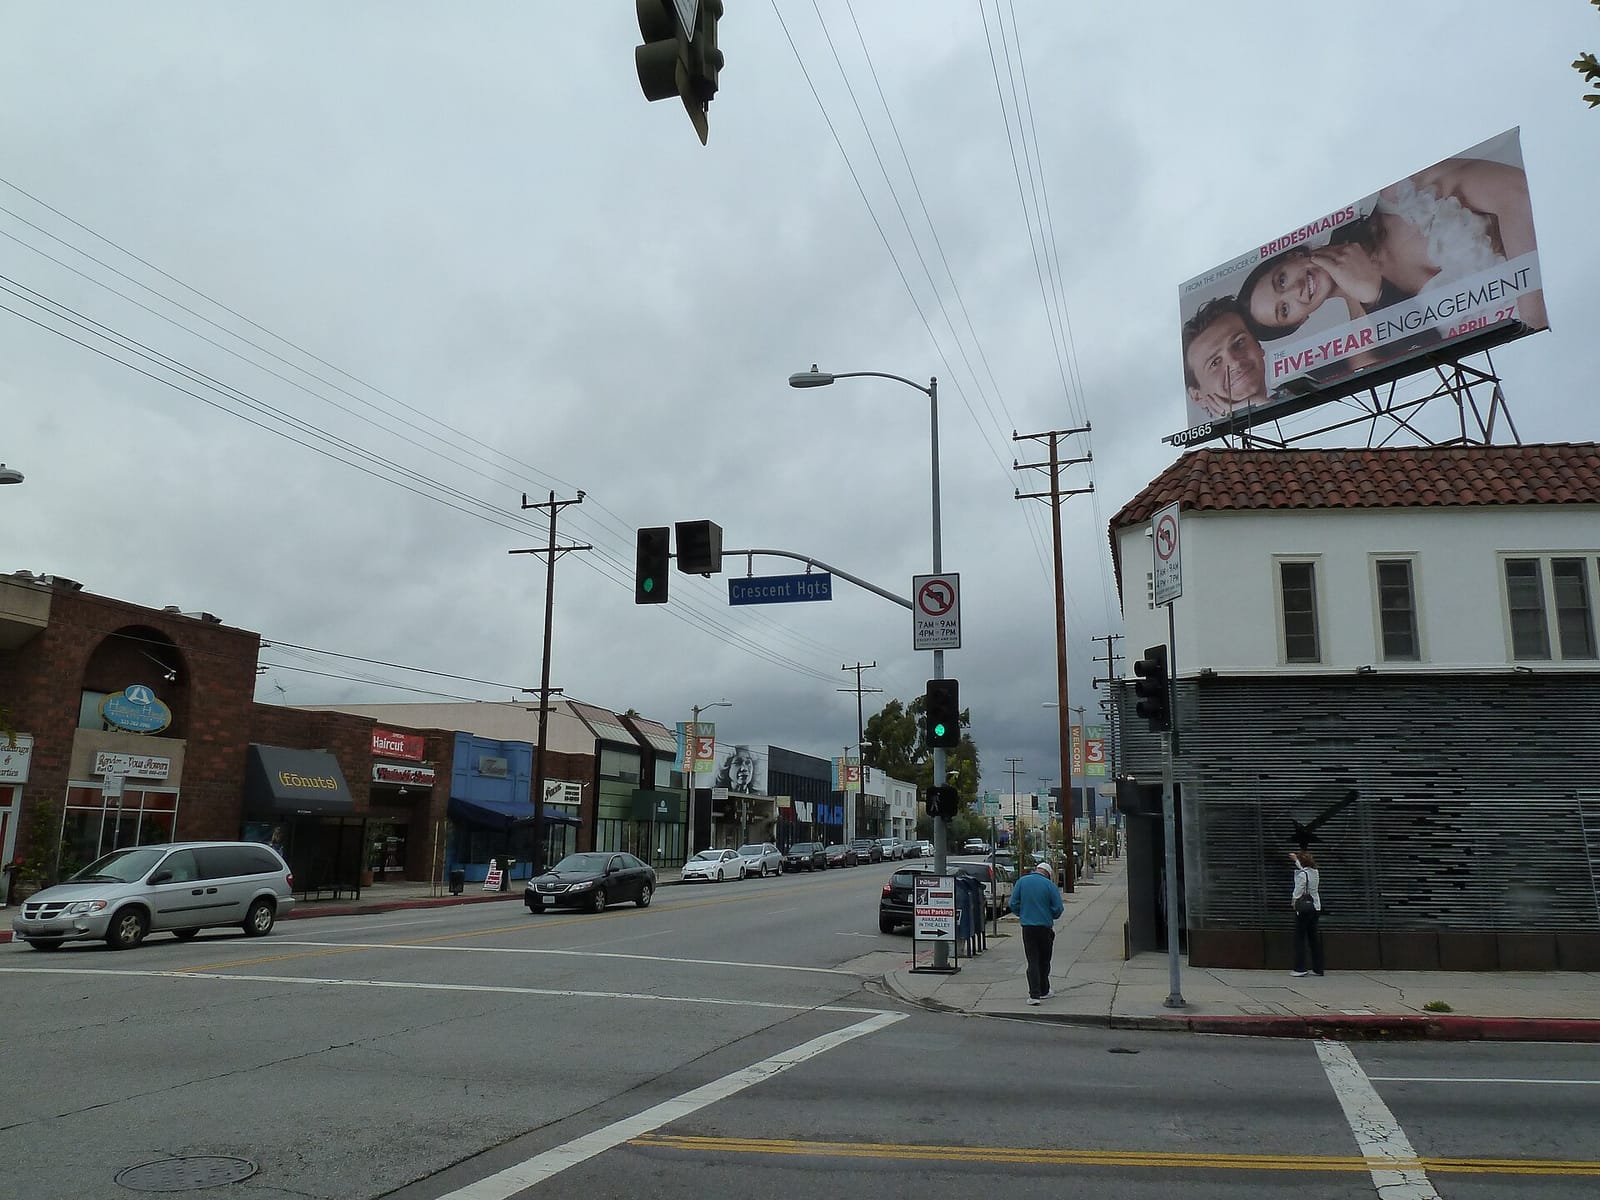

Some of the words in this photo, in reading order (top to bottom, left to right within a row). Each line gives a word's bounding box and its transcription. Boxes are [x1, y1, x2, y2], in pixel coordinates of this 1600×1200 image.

[1185, 280, 1203, 294] FROM
[1203, 273, 1216, 286] THE
[1216, 259, 1249, 279] PRODUCER
[1260, 206, 1355, 259] BRIDESMAIDS
[1273, 327, 1374, 378] FIVE-YEAR
[1376, 267, 1531, 342] ENGAGEMENT
[1446, 316, 1489, 339] APRIL
[1494, 305, 1516, 322] 27
[1273, 350, 1287, 361] THE
[1173, 423, 1212, 445] 001565
[732, 582, 791, 599] Crescent
[797, 580, 828, 599] Hgts
[917, 621, 934, 629] 7AM
[940, 619, 957, 628] 9AM
[918, 630, 934, 638] 4PM
[940, 628, 956, 636] 7PM
[700, 724, 712, 735] W
[1087, 727, 1102, 739] W
[373, 735, 405, 752] Haircut
[684, 723, 693, 769] WELCOME
[698, 738, 713, 758] 3
[1072, 727, 1081, 773] WELCOME
[1087, 741, 1103, 762] 3
[697, 761, 711, 770] ST
[847, 767, 858, 781] 3
[1087, 764, 1104, 774] ST
[931, 909, 953, 917] Parking
